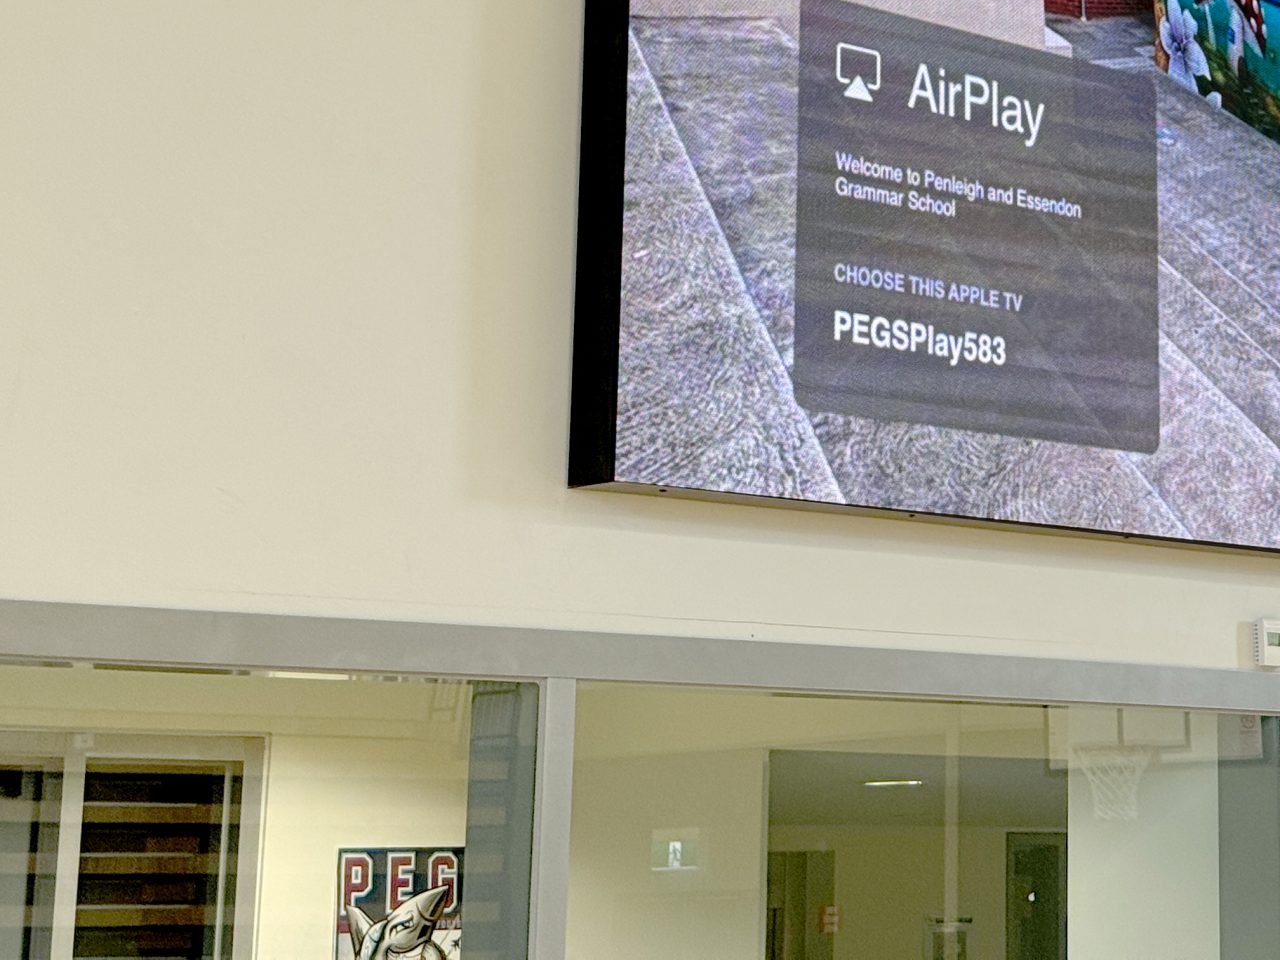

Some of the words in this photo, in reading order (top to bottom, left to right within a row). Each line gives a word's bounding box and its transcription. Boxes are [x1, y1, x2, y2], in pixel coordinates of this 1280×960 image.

[907, 63, 1046, 147] AirPlay
[835, 150, 903, 183] Welcome
[907, 167, 920, 186] to
[924, 169, 984, 202] Penleigh
[987, 186, 1014, 205] and
[1016, 188, 1082, 219] Essendon
[835, 176, 904, 207] Grammar
[908, 190, 956, 217] School
[833, 262, 905, 293] CHOOSE
[908, 274, 945, 299] THIS
[948, 282, 1000, 308] APPLE
[1002, 291, 1024, 312] TV
[833, 310, 1007, 366] PEGSPlay583
